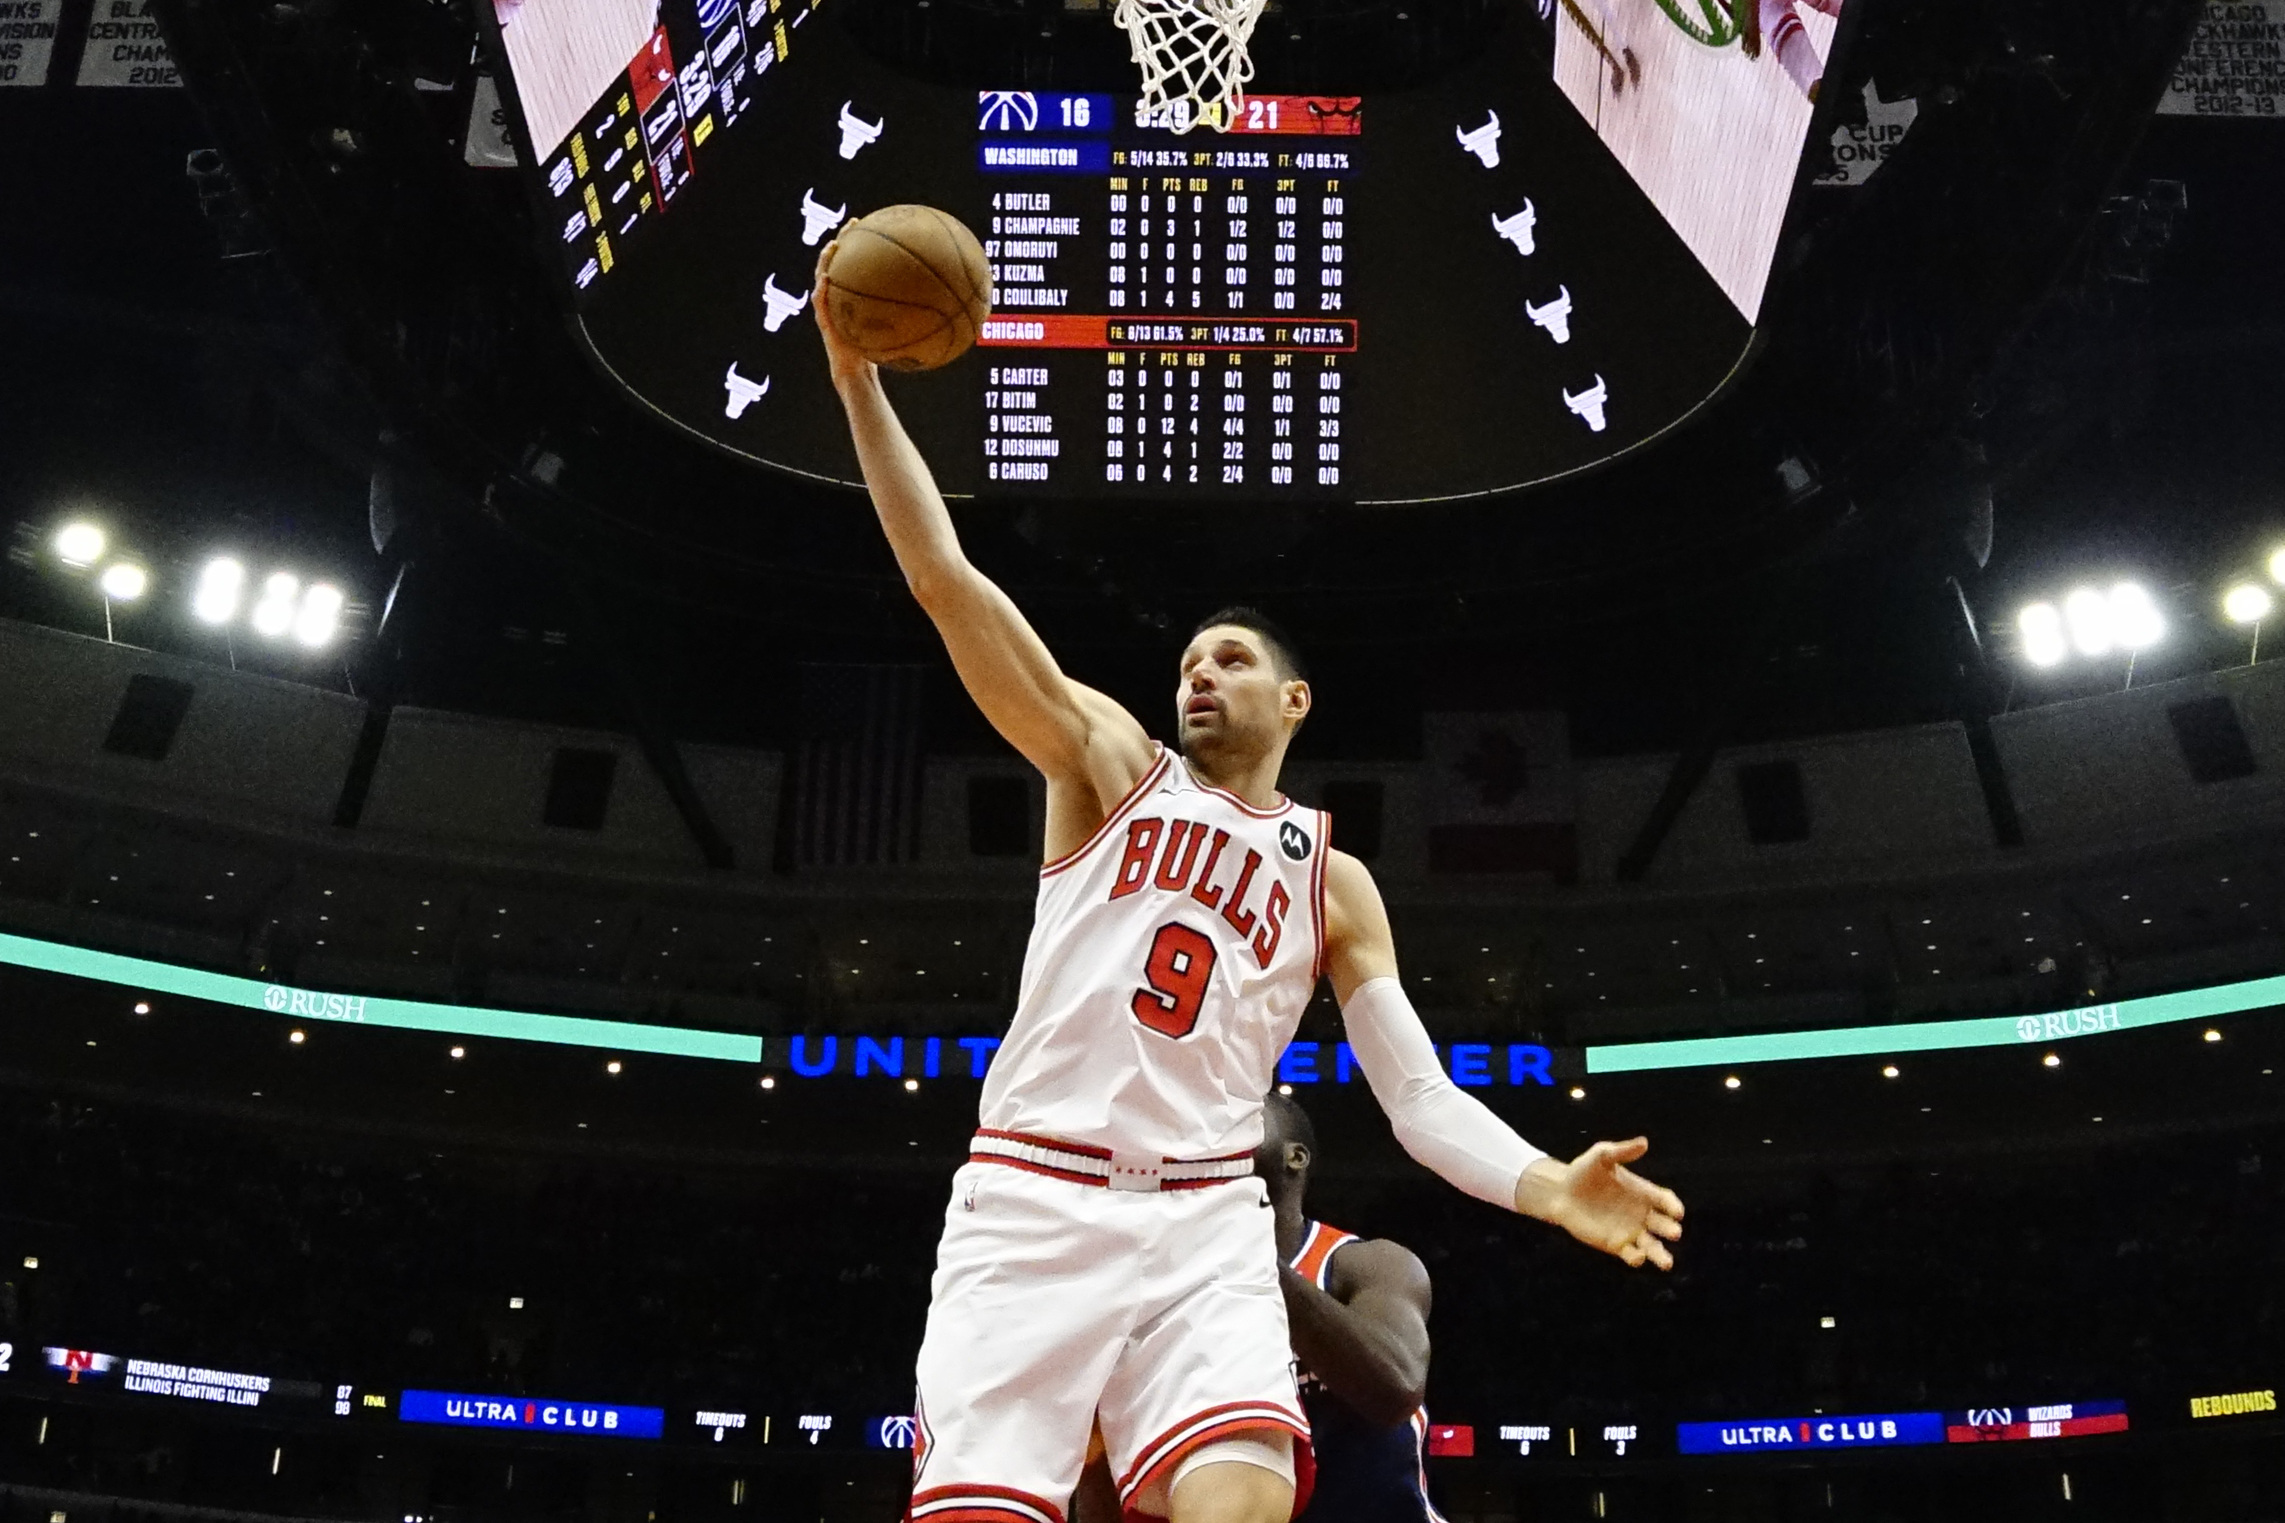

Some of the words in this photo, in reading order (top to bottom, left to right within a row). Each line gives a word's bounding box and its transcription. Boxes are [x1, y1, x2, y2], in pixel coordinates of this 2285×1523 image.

[1061, 99, 1089, 126] 16
[1249, 101, 1277, 129] 21
[985, 148, 1077, 165] WASHINGTON
[1130, 150, 1154, 168] 5/14
[1156, 151, 1187, 166] 35.7%
[1216, 152, 1235, 168] 2/6
[1236, 152, 1269, 167] 33.3%
[1296, 153, 1314, 170] 4/6
[1110, 177, 1128, 190] MIN
[1163, 178, 1181, 191] PTS
[1190, 178, 1207, 191] REB
[1232, 179, 1243, 190] FG
[1277, 180, 1295, 191] 3PT
[1328, 180, 1338, 192] FT
[993, 193, 1001, 210] 4
[1005, 193, 1050, 210] BUTLER
[1111, 195, 1126, 212] 00
[1141, 195, 1149, 212] 0
[1168, 196, 1175, 212] 0
[1194, 196, 1201, 212] 0
[1227, 196, 1247, 213] 0/0
[993, 217, 1000, 233] 9
[1004, 217, 1080, 235] CHAMPAGNIE
[1110, 218, 1126, 235] 02
[1141, 219, 1149, 236] 0
[1167, 219, 1175, 236] 3
[1194, 220, 1200, 236] 1
[1229, 219, 1247, 237] 1/2
[1278, 220, 1295, 238] 1/2
[985, 241, 1000, 259] 97
[1004, 241, 1057, 258] OMORUYI
[1110, 242, 1126, 259] 00
[1140, 243, 1148, 259] 0
[1167, 243, 1174, 260] 0
[1193, 243, 1201, 260] 0
[1226, 243, 1247, 261] 0/0
[1004, 265, 1044, 282] KUZMA
[1110, 266, 1125, 283] 08
[1141, 267, 1146, 283] 1
[1166, 267, 1174, 283] 0
[1192, 267, 1200, 284] 0
[1226, 267, 1246, 285] 0/0
[1004, 288, 1068, 306] COULIBALY
[1110, 290, 1125, 307] 08
[1140, 290, 1146, 307] 1
[1165, 291, 1174, 307] 4
[1192, 291, 1200, 307] 5
[1228, 291, 1243, 308] 1/1
[1321, 292, 1341, 310] 2/4
[982, 322, 1043, 339] CHICAGO
[1153, 326, 1183, 340] 61.5%
[1214, 326, 1230, 343] 1/4
[1232, 327, 1265, 342] 25.0%
[1293, 327, 1311, 344] 4/7
[1313, 328, 1343, 343] 57.1%
[1108, 352, 1125, 364] MIN
[1161, 353, 1178, 366] PTS
[1187, 353, 1205, 366] REB
[1229, 353, 1241, 364] FG
[1274, 354, 1292, 365] 3PT
[1325, 355, 1335, 366] FT
[991, 368, 998, 384] 5
[1003, 368, 1048, 385] CARTER
[1108, 370, 1124, 386] 03
[1138, 370, 1147, 386] 0
[1165, 370, 1173, 387] 0
[1191, 371, 1199, 387] 0
[1225, 371, 1242, 388] 0/1
[1273, 371, 1290, 389] 0/1
[986, 392, 998, 408] 17
[1002, 392, 1036, 408] BITIM
[1108, 393, 1123, 410] 02
[1139, 394, 1144, 410] 1
[1164, 394, 1172, 411] 0
[1190, 394, 1198, 411] 2
[990, 415, 998, 432] 9
[1002, 415, 1052, 433] VUCEVIC
[1108, 417, 1123, 433] 08
[1138, 417, 1146, 434] 0
[1161, 418, 1174, 434] 12
[1190, 418, 1198, 434] 4
[1223, 418, 1244, 435] 4/4
[1275, 418, 1290, 436] 1/1
[1320, 419, 1339, 437] 3/3
[985, 439, 997, 455] 12
[1002, 439, 1059, 456] DOSUNMU
[1107, 440, 1123, 457] 08
[1139, 441, 1144, 457] 1
[1163, 441, 1171, 458] 4
[1191, 442, 1196, 458] 1
[1223, 441, 1243, 459] 2/2
[990, 463, 997, 479] 6
[1001, 462, 1048, 480] CARUSO
[1107, 464, 1123, 481] 06
[1137, 464, 1145, 481] 0
[1163, 465, 1171, 482] 4
[1189, 465, 1197, 482] 2
[1223, 465, 1243, 483] 2/4
[1109, 817, 1291, 970] BULLS
[1131, 921, 1218, 1040] 9
[288, 988, 367, 1022] RUSH
[2044, 1003, 2122, 1038] RUSH
[127, 1358, 187, 1382] NEBRASKA
[187, 1366, 270, 1392] CORNHUSKERS
[124, 1374, 172, 1396] ILLINOIS
[172, 1381, 226, 1402] FIGHTING
[364, 1395, 386, 1407] FINAL
[2191, 1390, 2276, 1418] REBOUNDS
[447, 1401, 516, 1420] ULTRA
[543, 1407, 617, 1428] CLUB
[696, 1411, 746, 1428] TIMEOUTS
[799, 1415, 832, 1430] FOULS
[2028, 1404, 2072, 1422] WIZARDS
[1500, 1426, 1550, 1440] TIMEOUTS
[1604, 1426, 1637, 1441] FOULS
[1723, 1427, 1792, 1444] ULTRA
[1819, 1421, 1896, 1441] CLUB
[2030, 1422, 2061, 1437] BULLS
